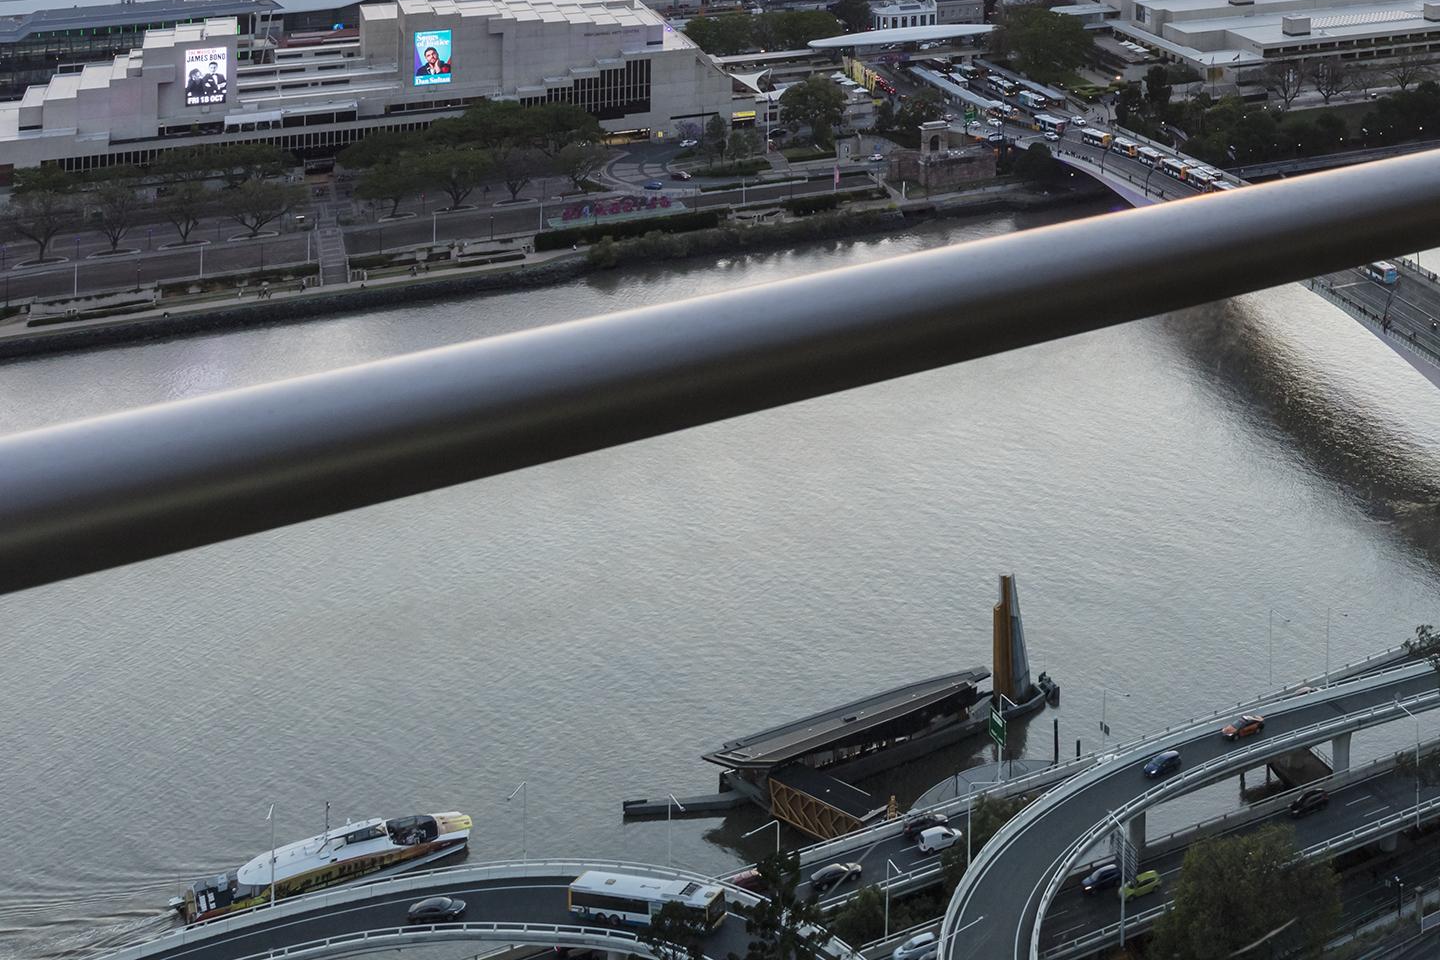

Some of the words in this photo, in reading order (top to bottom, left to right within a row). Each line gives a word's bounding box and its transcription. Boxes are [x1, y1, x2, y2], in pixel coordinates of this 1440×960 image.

[415, 78, 429, 86] Dan
[200, 95, 209, 103] 18
[210, 94, 224, 102] OCT
